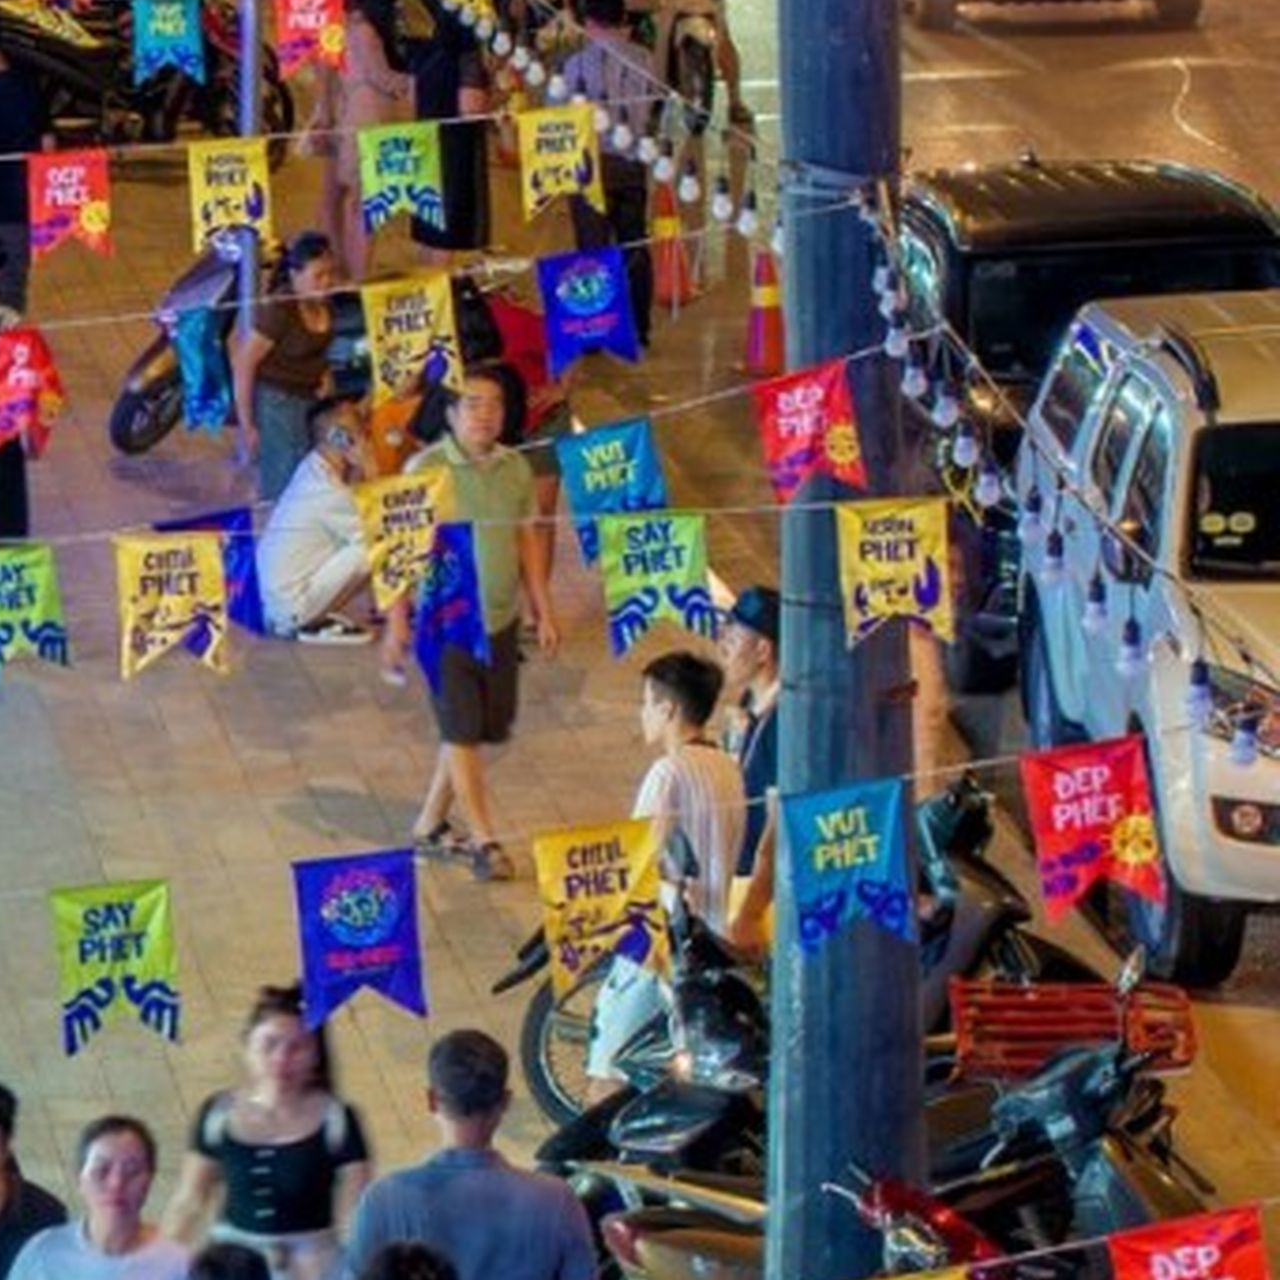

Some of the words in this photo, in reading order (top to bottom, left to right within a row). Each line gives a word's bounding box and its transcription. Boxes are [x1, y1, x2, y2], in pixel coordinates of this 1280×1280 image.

[626, 522, 672, 550] SAY
[815, 811, 868, 837] VUI
[82, 904, 136, 934] SAY
